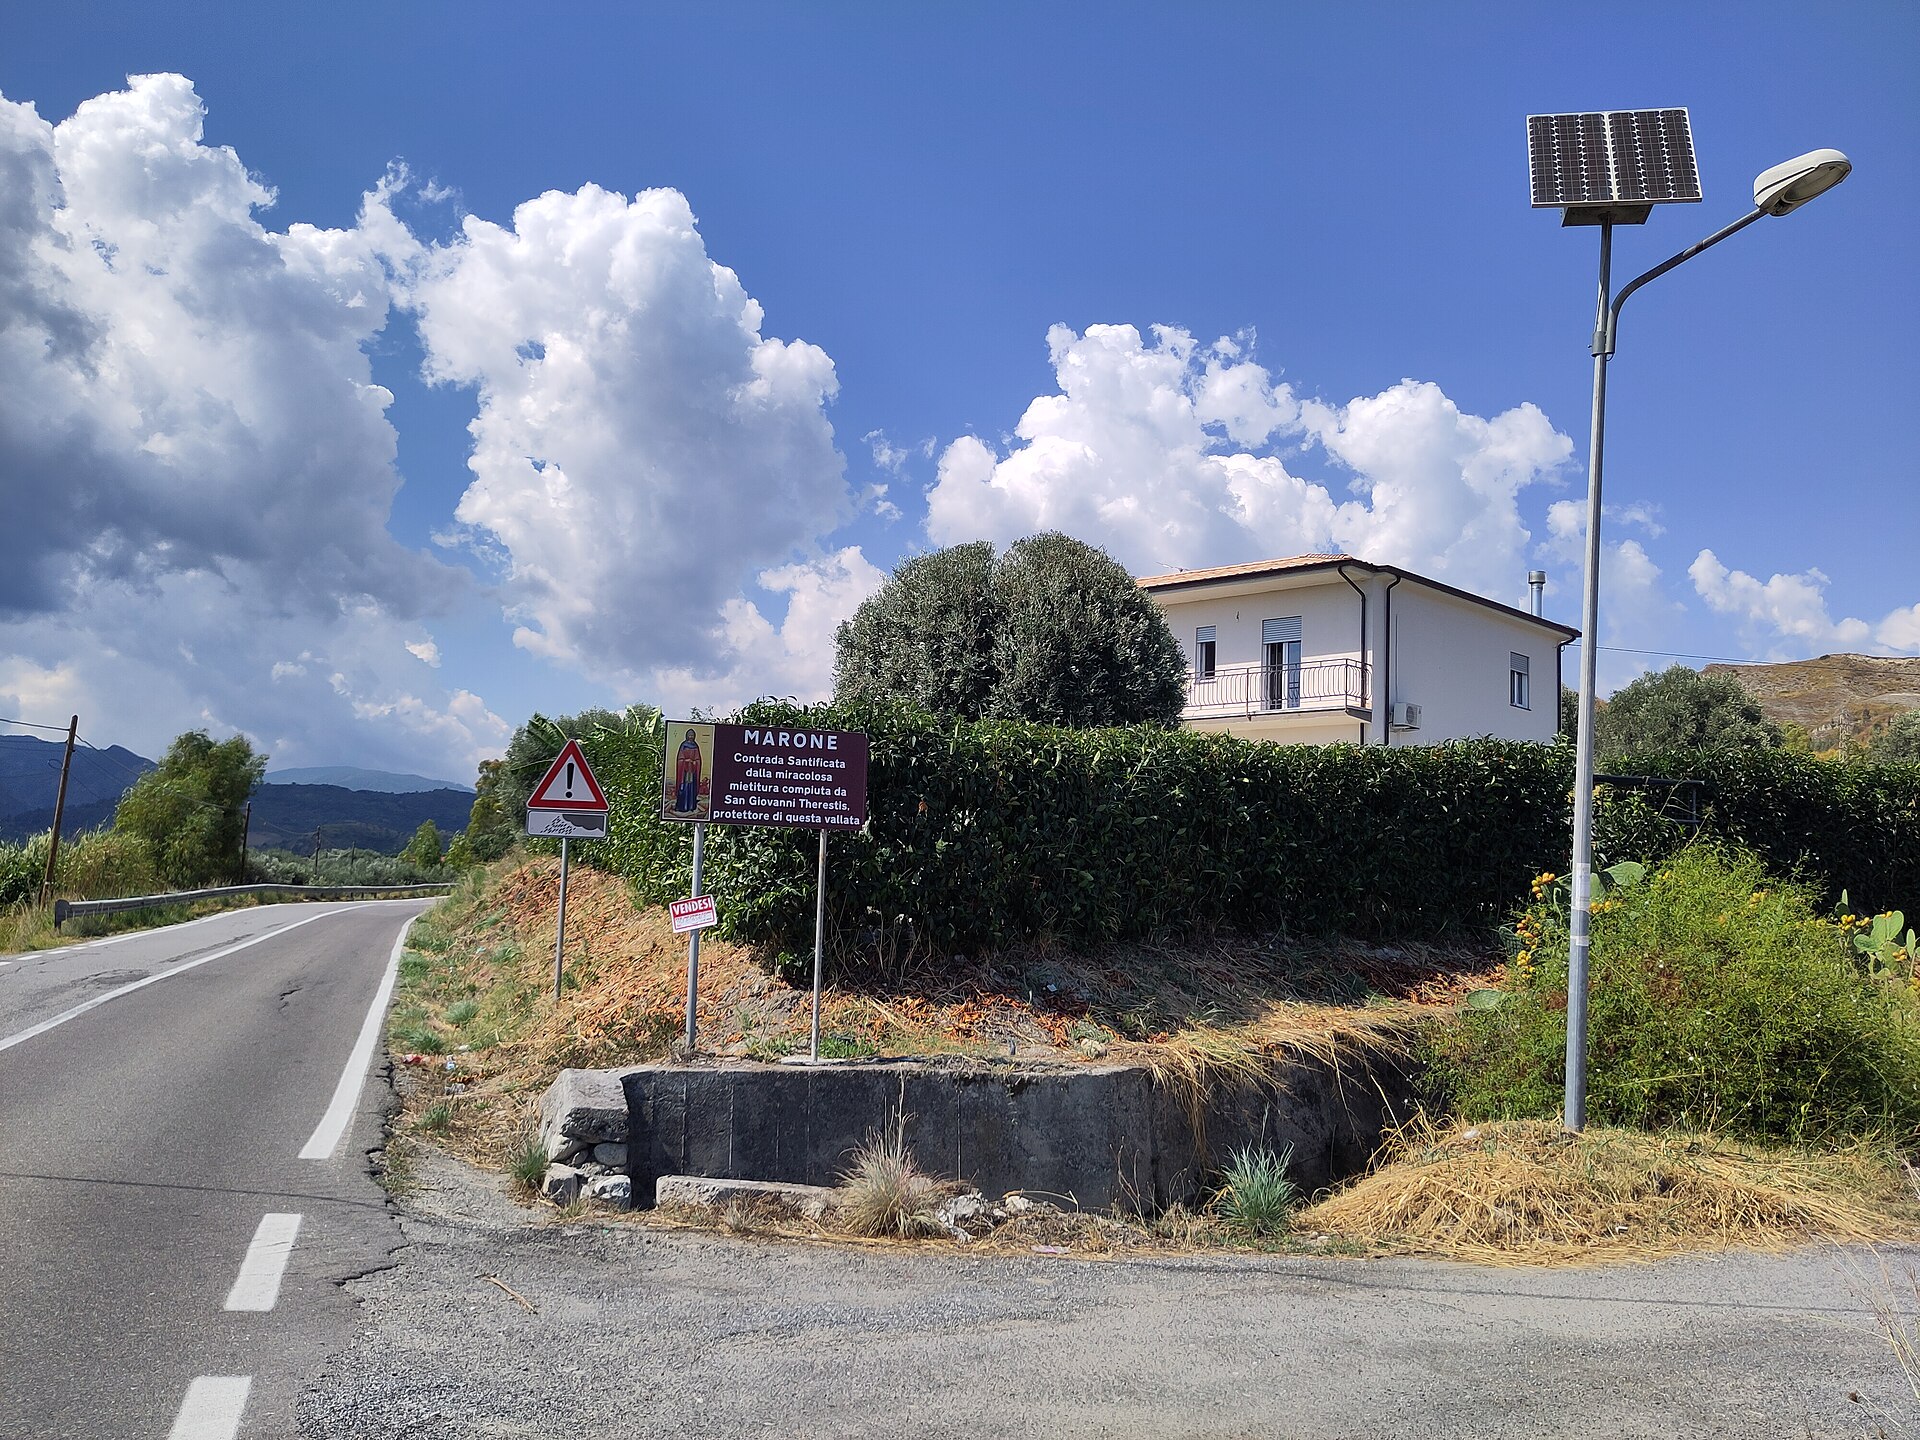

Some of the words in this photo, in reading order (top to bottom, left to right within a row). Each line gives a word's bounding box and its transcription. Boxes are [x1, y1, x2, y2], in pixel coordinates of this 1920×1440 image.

[744, 730, 838, 750] MARONE
[734, 753, 784, 765] Contrada
[787, 756, 846, 769] Santificata
[746, 768, 772, 778] dalla
[776, 770, 833, 782] miracolosa
[730, 782, 779, 793] mietitura
[782, 785, 831, 796] compiuta
[834, 786, 847, 797] da
[724, 795, 745, 805] San
[749, 796, 796, 808] Giovanni
[713, 809, 769, 821] protettore
[773, 811, 782, 821] di
[786, 813, 821, 824] questa
[825, 815, 860, 825] vallata
[673, 897, 712, 915] VENDESI
